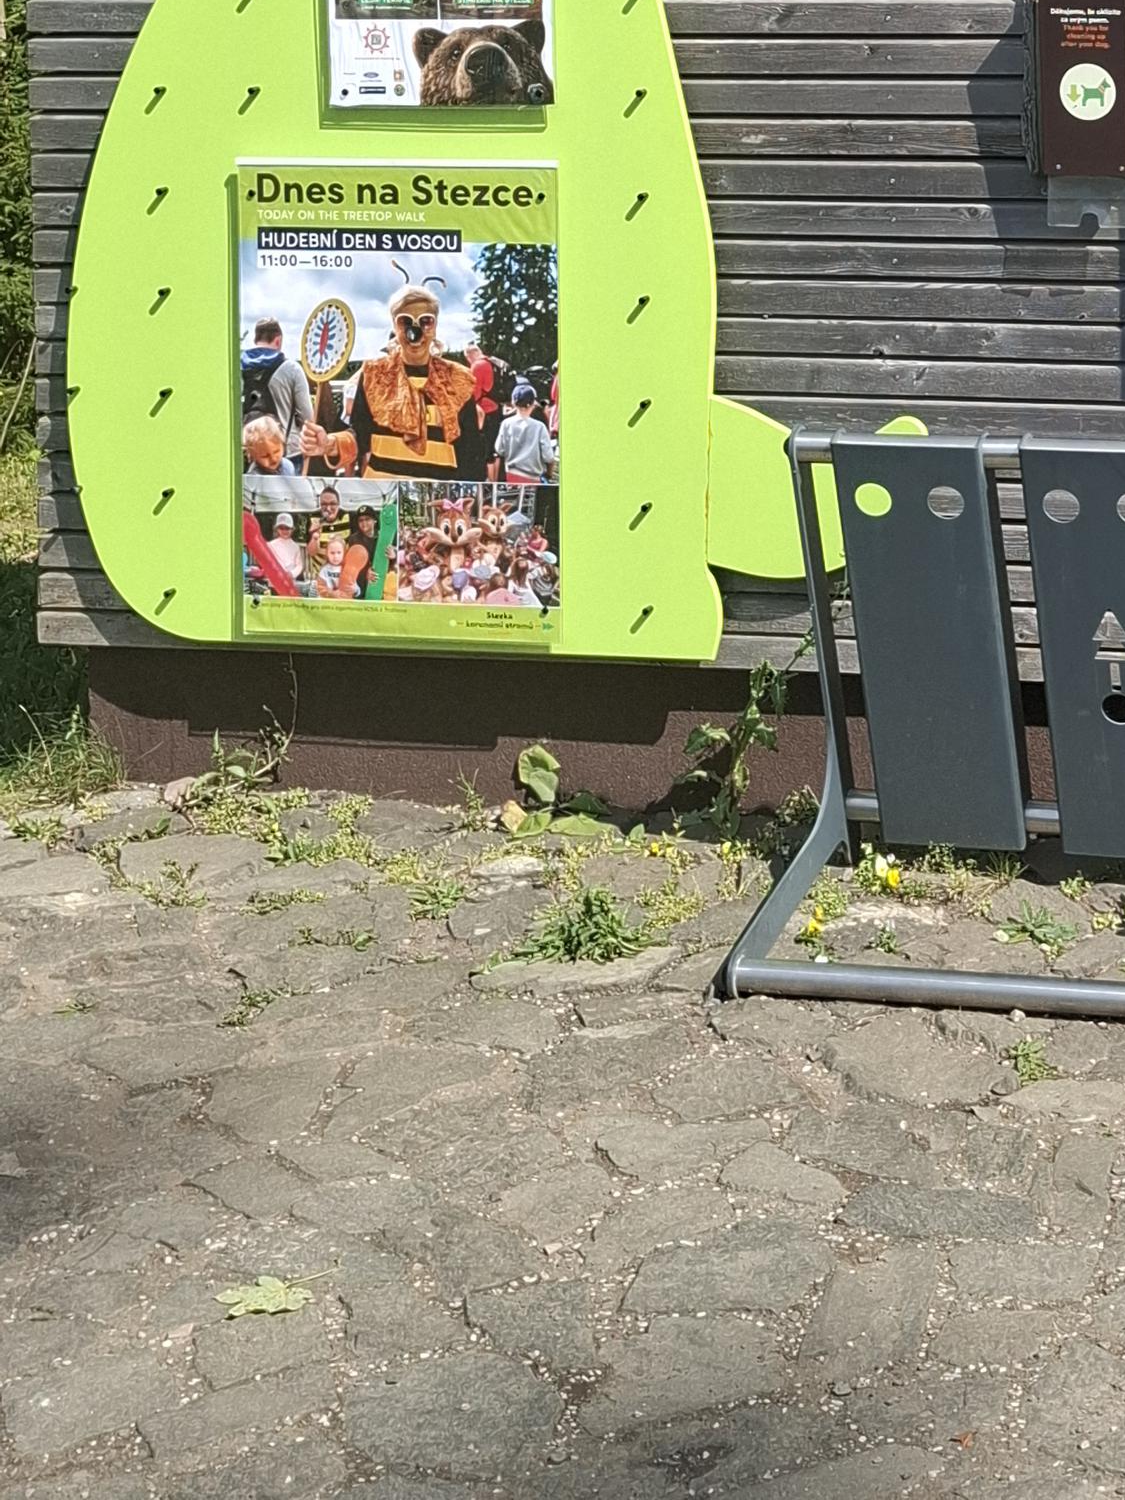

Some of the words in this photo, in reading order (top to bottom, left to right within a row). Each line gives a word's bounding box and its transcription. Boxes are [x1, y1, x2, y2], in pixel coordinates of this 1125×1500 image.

[256, 172, 345, 205] Dnes
[356, 181, 400, 206] na
[411, 174, 534, 207] Stezce
[257, 209, 295, 221] TODAY
[298, 209, 315, 221] ON
[319, 209, 339, 222] THE
[343, 210, 391, 222] TREETOP
[395, 211, 426, 223] WALK
[261, 229, 338, 249] HUDEBNÍ
[341, 232, 377, 249] DEN
[381, 233, 393, 250] S
[396, 234, 458, 250] VOSOU
